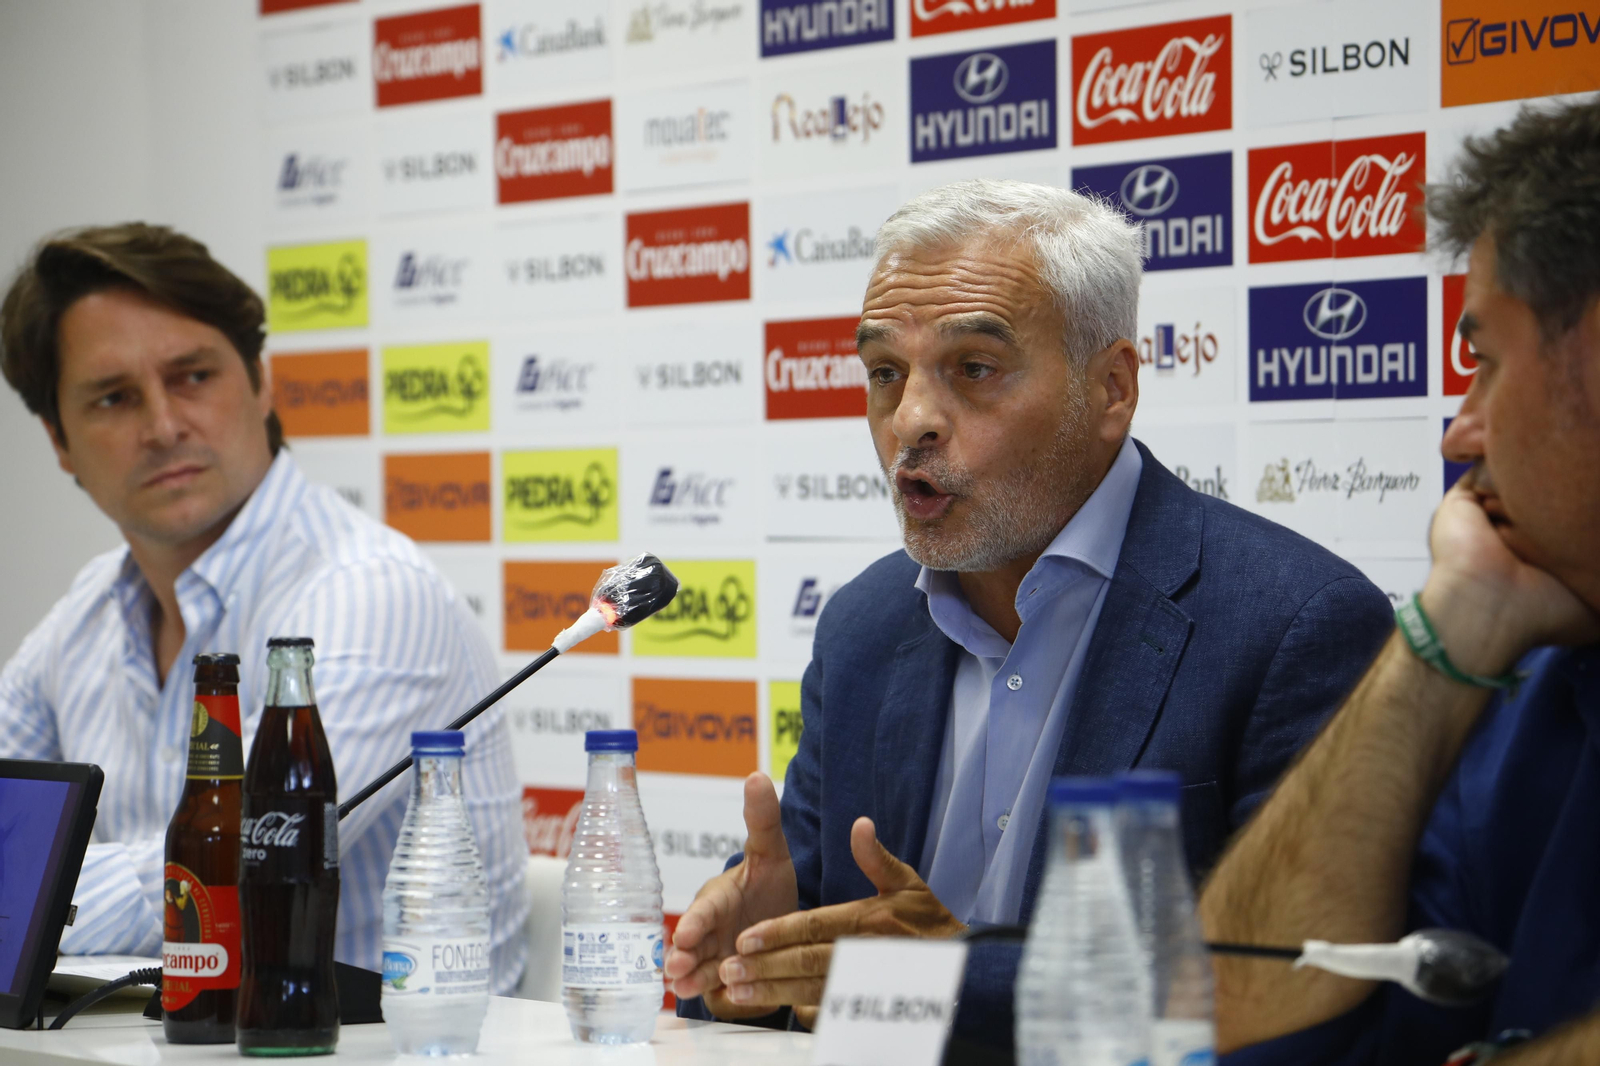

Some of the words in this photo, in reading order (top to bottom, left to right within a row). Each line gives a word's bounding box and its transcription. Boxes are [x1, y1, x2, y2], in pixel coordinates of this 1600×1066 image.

[763, 0, 890, 44] HYUNDAI
[1479, 12, 1600, 57] GIVOV
[1290, 37, 1410, 77] SILBON
[915, 99, 1049, 151] HYUNDAI
[495, 132, 611, 179] Cruzcampo
[625, 237, 748, 282] Cruzcampo
[1144, 214, 1222, 260] NDAI
[655, 361, 742, 390] SILBON
[766, 346, 869, 393] Cruzcam
[1256, 342, 1416, 388] HYUNDAI
[507, 475, 575, 510] PIEDRA
[796, 473, 889, 500] SILBON
[163, 953, 218, 973] campo
